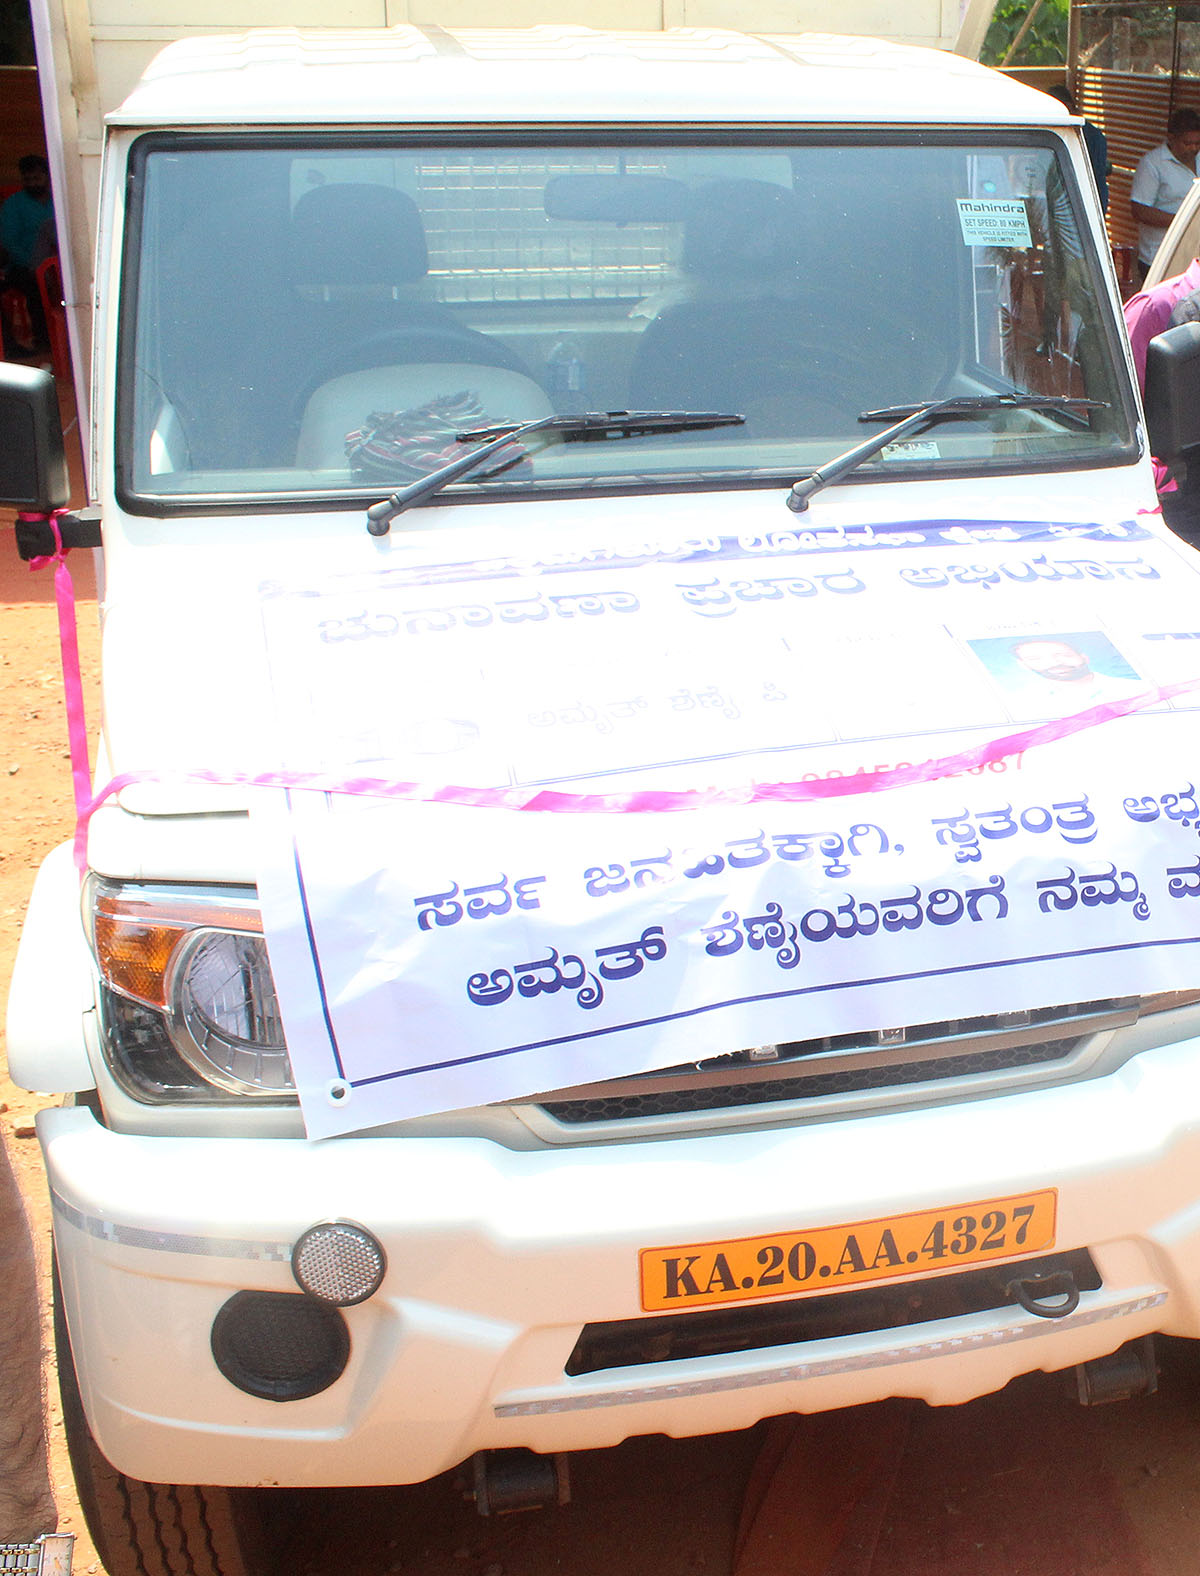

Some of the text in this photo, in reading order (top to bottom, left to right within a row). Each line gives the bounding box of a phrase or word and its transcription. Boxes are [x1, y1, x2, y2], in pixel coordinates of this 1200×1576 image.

[960, 203, 1025, 213] Mahindra
[965, 219, 976, 227] SET
[1008, 219, 1026, 228] KMPH
[317, 552, 1161, 645] ಚುನಾವಣಾ ಪ್ರಚಾರ ಅಭಿಯಾನ
[414, 871, 548, 931] ಸರ್ವ
[931, 793, 1099, 864] ಸ್ವತಂತ್ರ
[466, 923, 668, 1009] ಅಮೃತ್
[701, 875, 1009, 970] ಶೆಣೈಯವರಿಗೆ
[1036, 861, 1152, 922] ನಮ್ಮ
[661, 1203, 1036, 1300] KA.20.AA.4327
